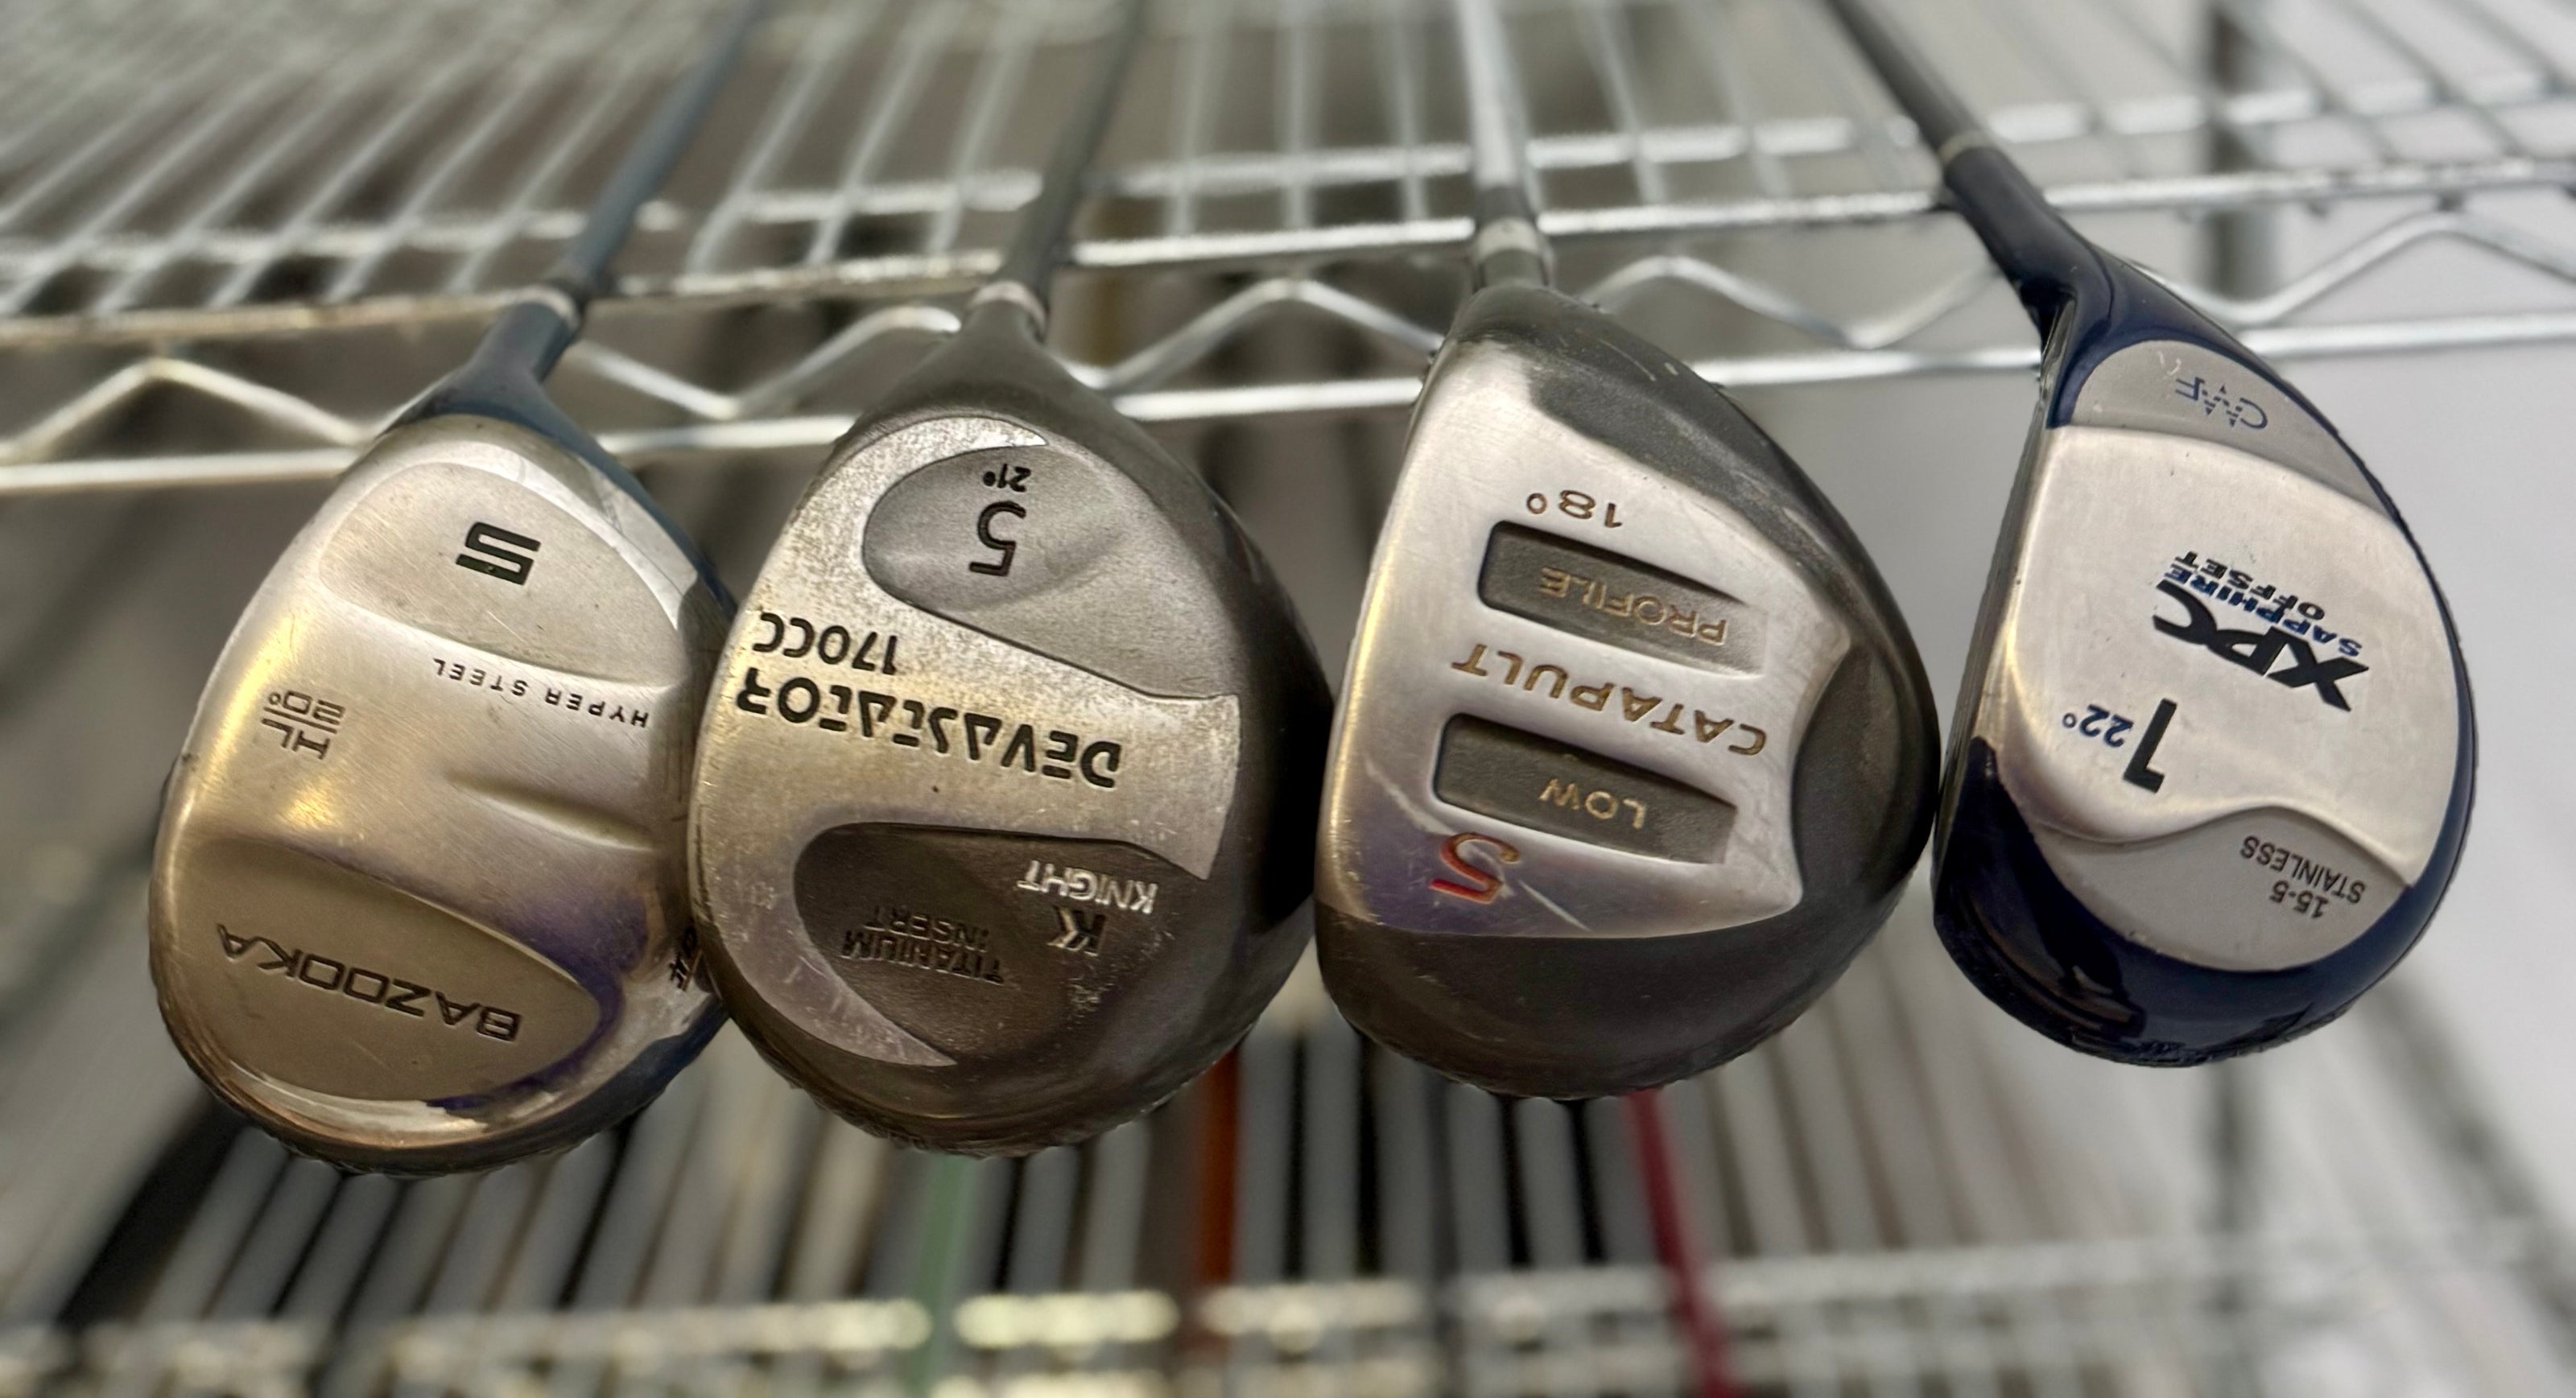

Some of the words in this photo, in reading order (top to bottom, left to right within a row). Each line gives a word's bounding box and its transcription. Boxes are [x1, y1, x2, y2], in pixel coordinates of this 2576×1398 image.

[969, 501, 1026, 576] 5
[1526, 489, 1623, 528] 18°
[1538, 566, 1730, 646] PROFILE
[2164, 563, 2363, 657] SAPPHIRE
[2174, 551, 2326, 621] OFFSET
[751, 612, 898, 675] 170CC
[2153, 579, 2369, 711] XPC
[432, 657, 529, 697] STEEL
[545, 687, 649, 728] HYPER
[1452, 643, 1768, 757] CATAPULT
[261, 718, 331, 760] HL
[736, 666, 1122, 790] DEVASTATOR
[2062, 703, 2134, 748] 22°
[1538, 777, 1647, 831] LOW
[1017, 860, 1159, 914] KNIGHT
[1430, 831, 1521, 905] 5
[2240, 835, 2366, 905] STAINLESS
[2268, 880, 2330, 918] 15-5
[839, 930, 1005, 986] TITANIUM
[864, 905, 990, 953] INSERT
[216, 922, 523, 1042] BAZOOKA
